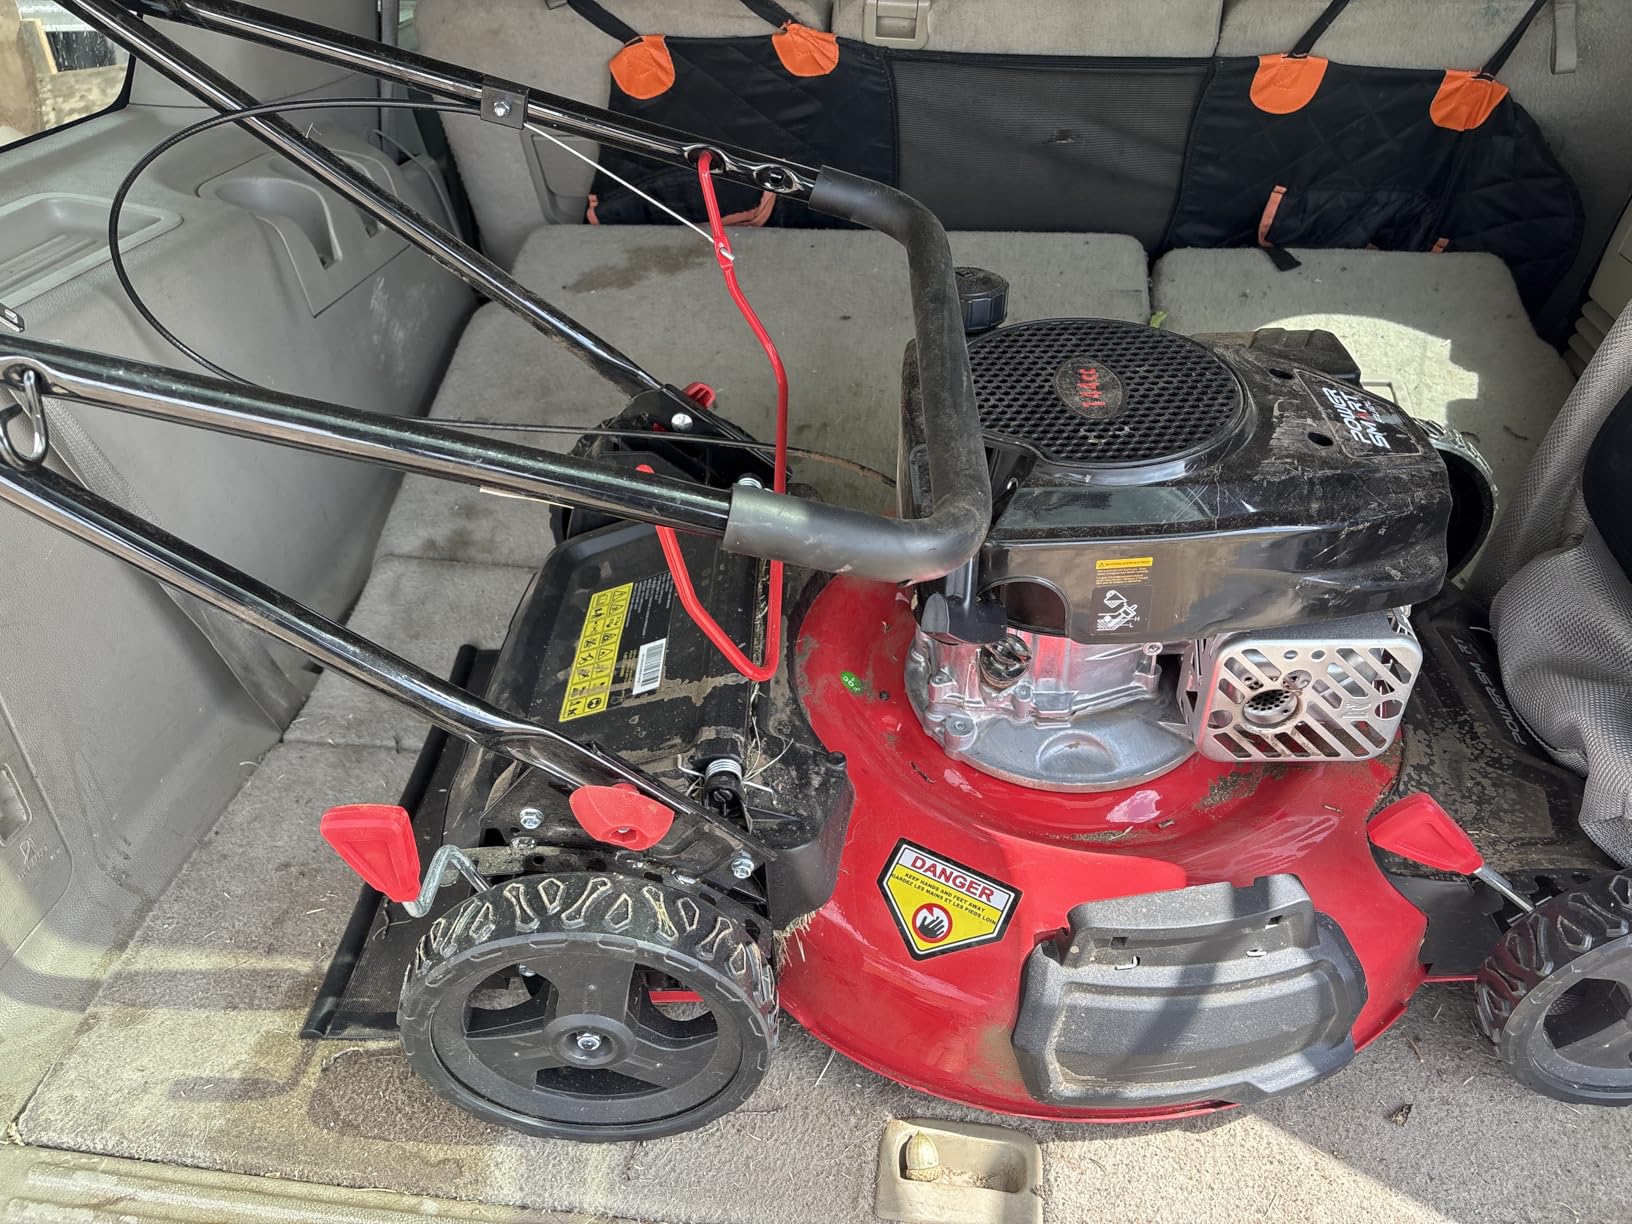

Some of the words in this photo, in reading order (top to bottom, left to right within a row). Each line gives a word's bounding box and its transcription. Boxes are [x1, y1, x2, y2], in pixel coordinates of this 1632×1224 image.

[1077, 368, 1106, 408] 144cc
[1322, 387, 1371, 444] POWER
[1340, 391, 1391, 450] SMART
[891, 873, 913, 887] GARDEZ
[914, 883, 926, 892] LES
[925, 887, 945, 901] MAINS
[944, 897, 953, 905] ET
[953, 901, 965, 911] LES
[965, 907, 982, 919] PIEDS
[982, 914, 997, 926] LOIN
[904, 873, 920, 883] KEEP
[920, 879, 940, 892] HANDS
[940, 888, 953, 898] AND
[953, 894, 968, 905] FEET
[968, 901, 986, 913] AWAY
[910, 855, 995, 903] DANGER
